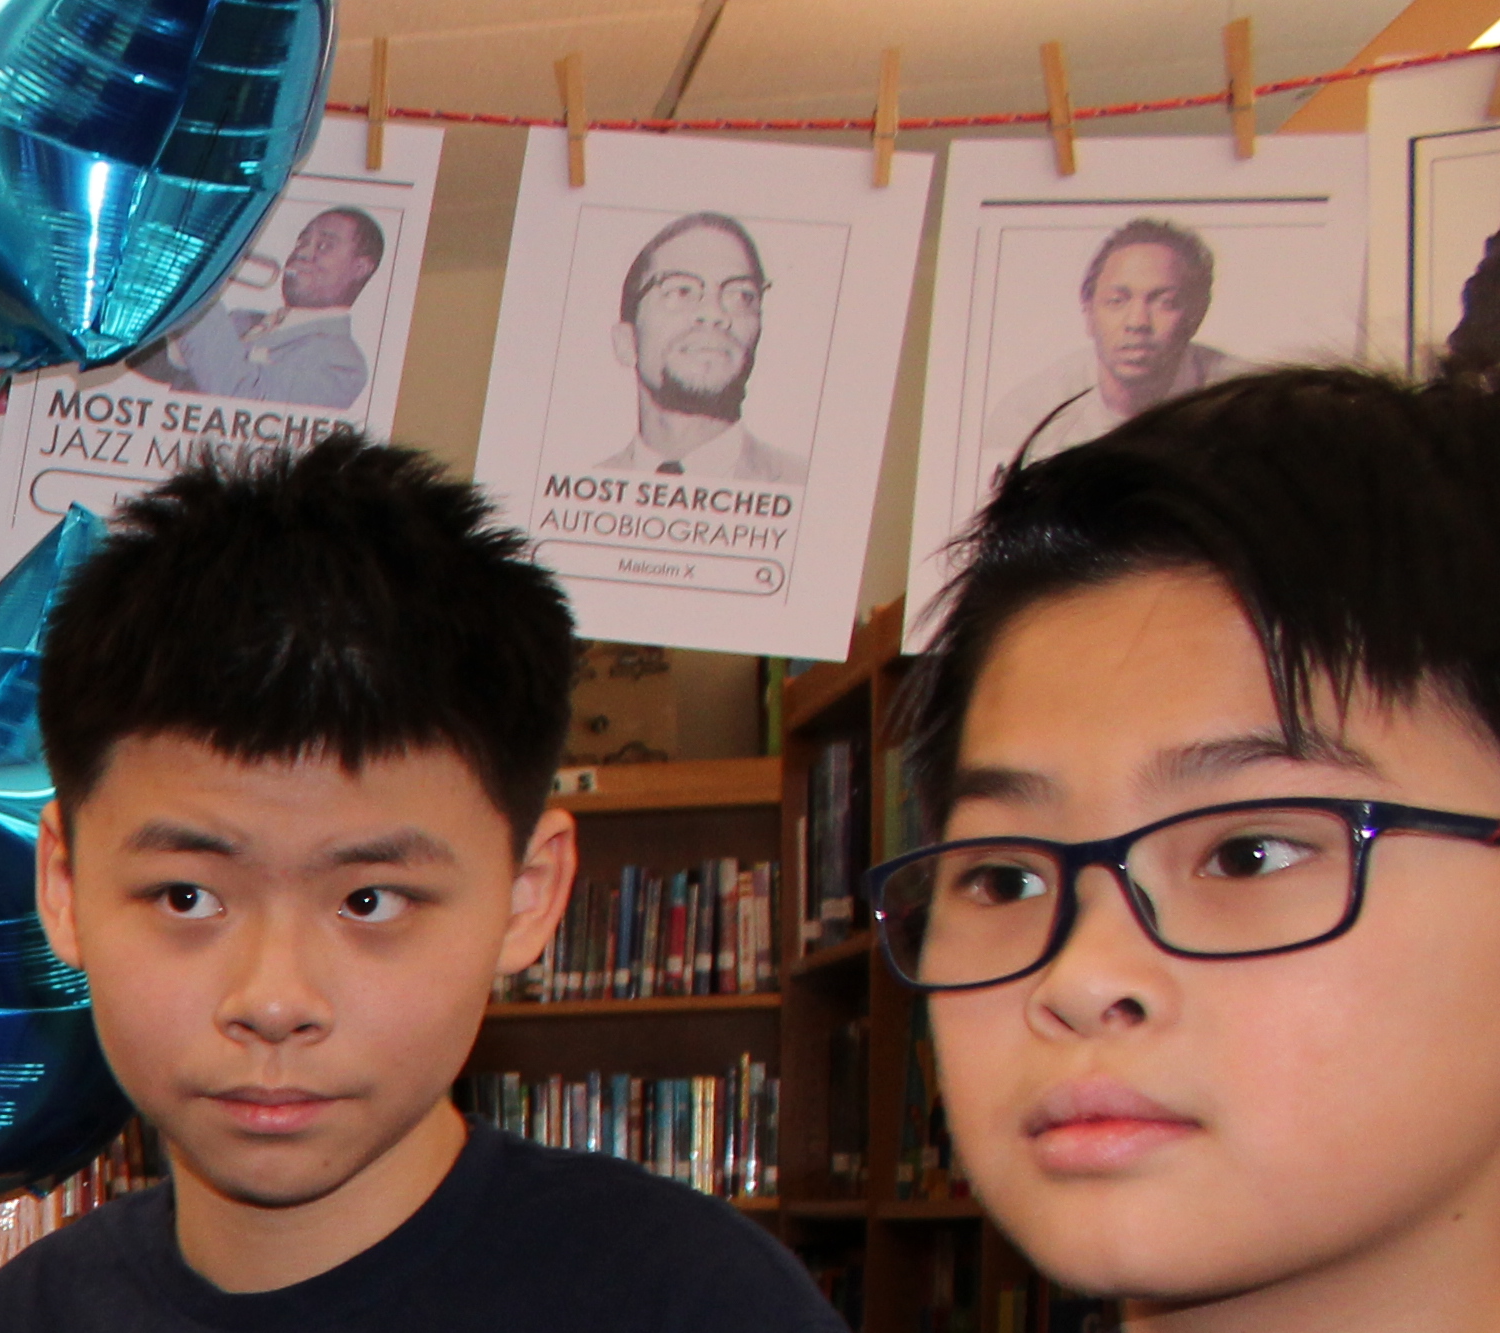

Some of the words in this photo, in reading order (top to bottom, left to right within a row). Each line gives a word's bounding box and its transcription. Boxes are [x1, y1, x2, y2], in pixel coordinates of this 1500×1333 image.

[48, 389, 152, 427] MOST
[40, 424, 133, 465] JAZZ
[544, 473, 630, 504] MOST
[636, 481, 792, 518] SEARCHED
[539, 508, 788, 550] AUTOBIOGRAPHY
[618, 558, 680, 578] Malcolm
[683, 565, 696, 578] X
